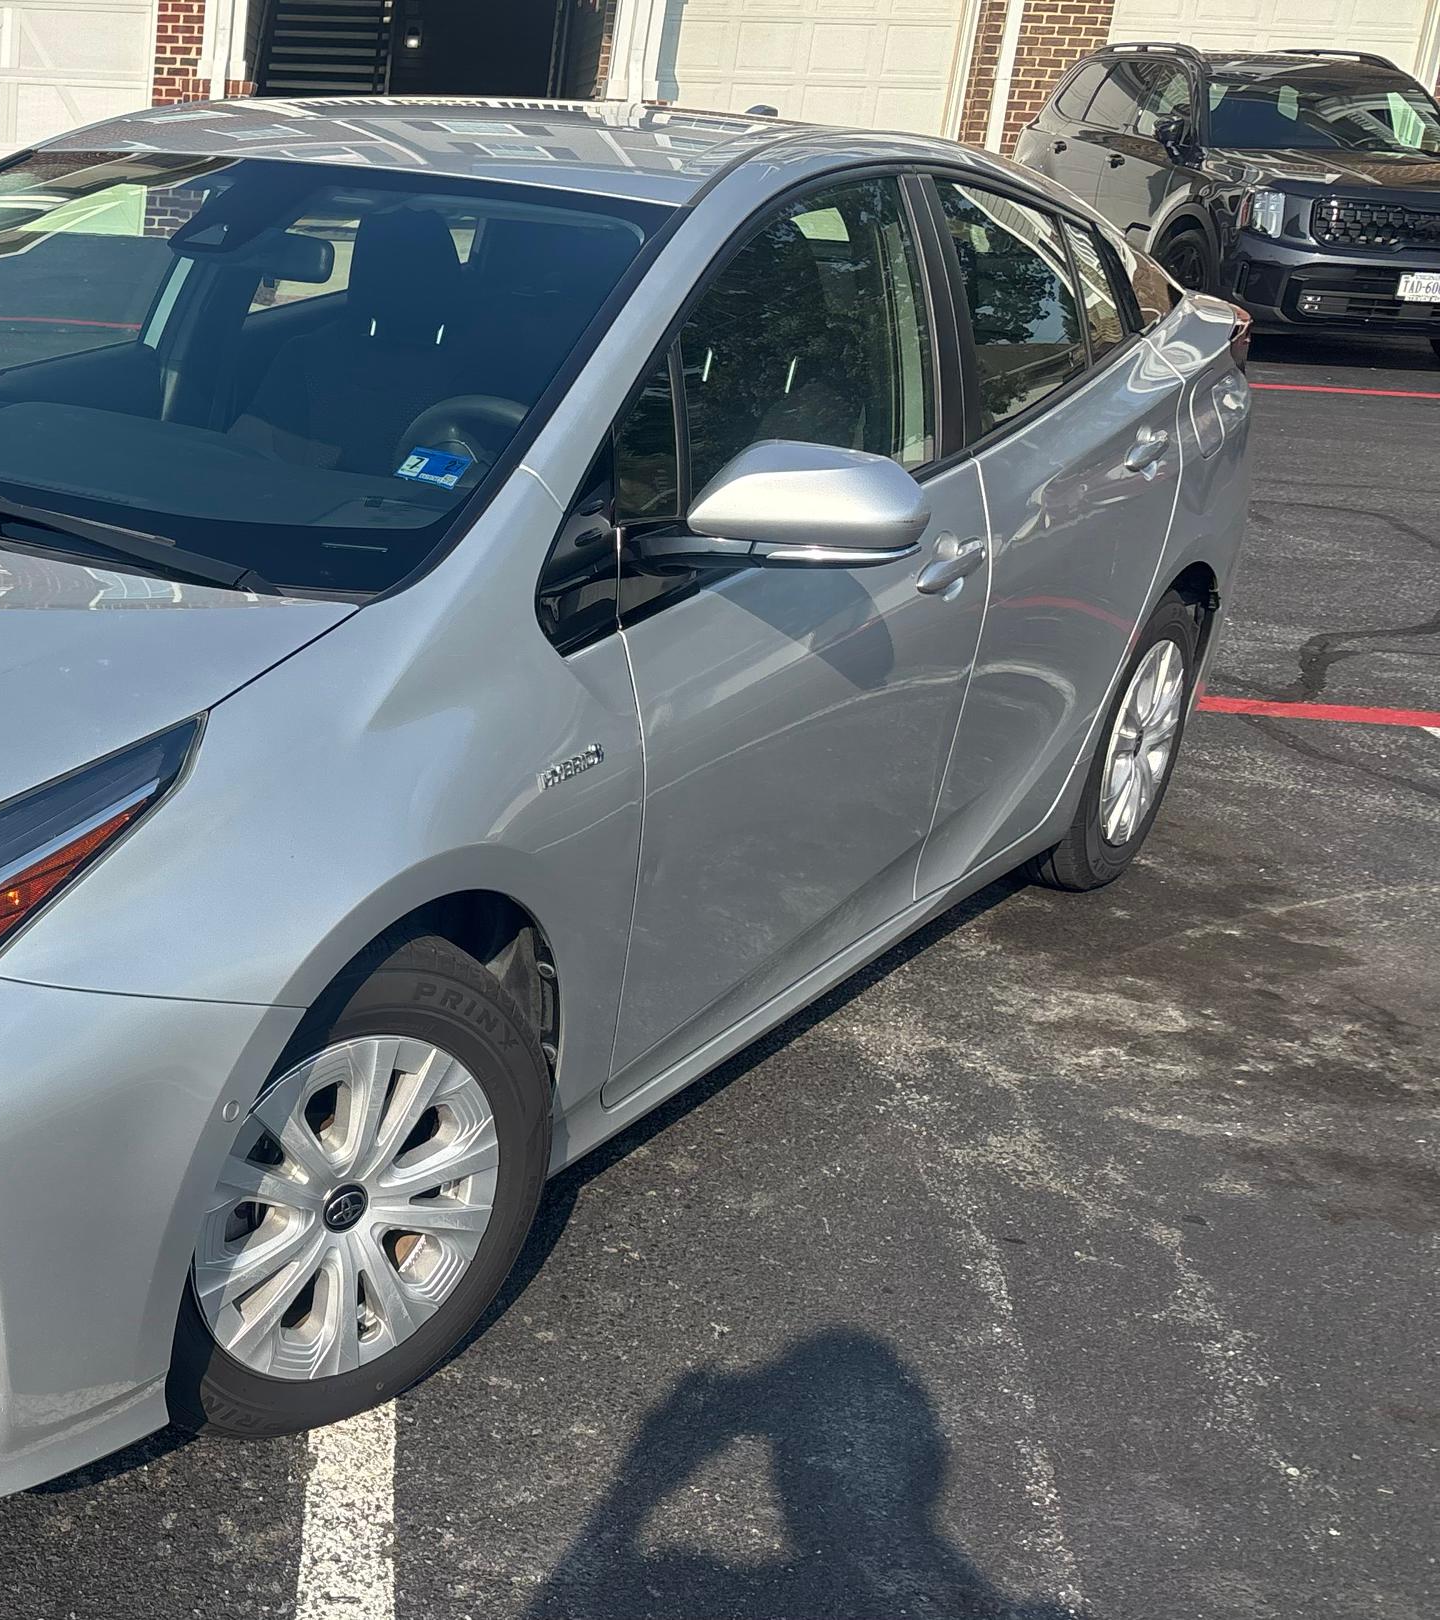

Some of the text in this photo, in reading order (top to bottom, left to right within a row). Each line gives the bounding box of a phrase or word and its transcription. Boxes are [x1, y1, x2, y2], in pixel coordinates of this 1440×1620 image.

[1403, 280, 1440, 294] TAD-60
[410, 457, 425, 470] 7
[535, 743, 605, 793] HYBRID
[413, 982, 520, 1052] PRINX
